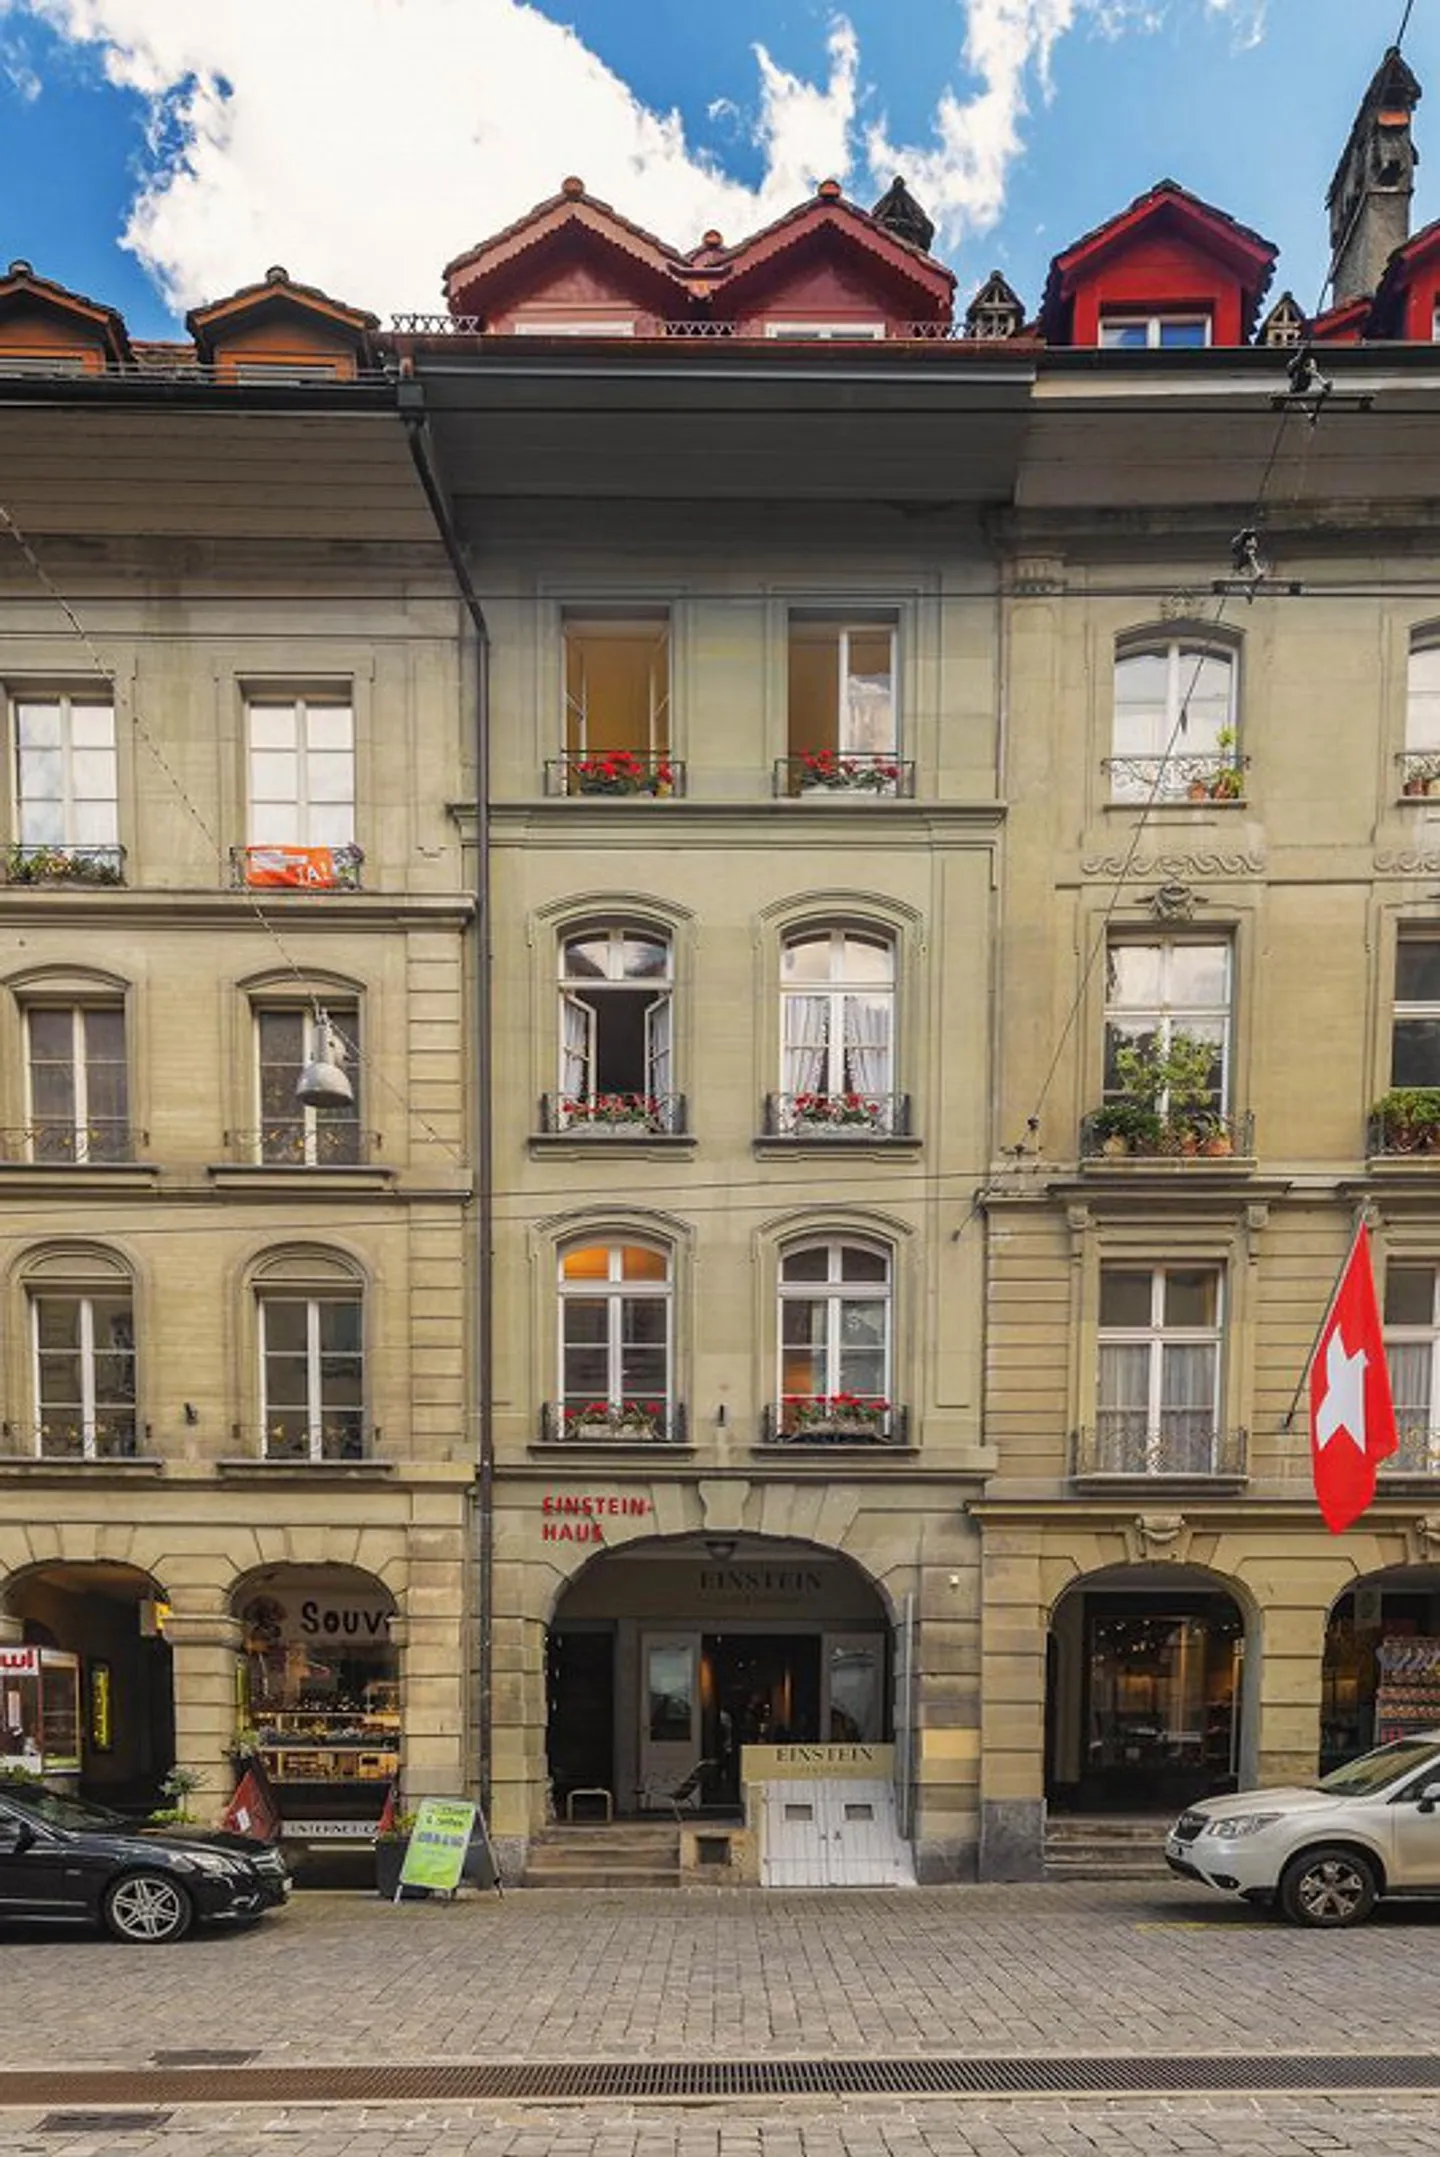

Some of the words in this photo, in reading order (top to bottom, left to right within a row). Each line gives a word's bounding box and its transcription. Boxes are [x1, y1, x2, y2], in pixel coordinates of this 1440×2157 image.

[541, 1523, 603, 1543] HAUS
[700, 1571, 822, 1591] EINSTEIN
[776, 1747, 873, 1762] EINSTEIN
